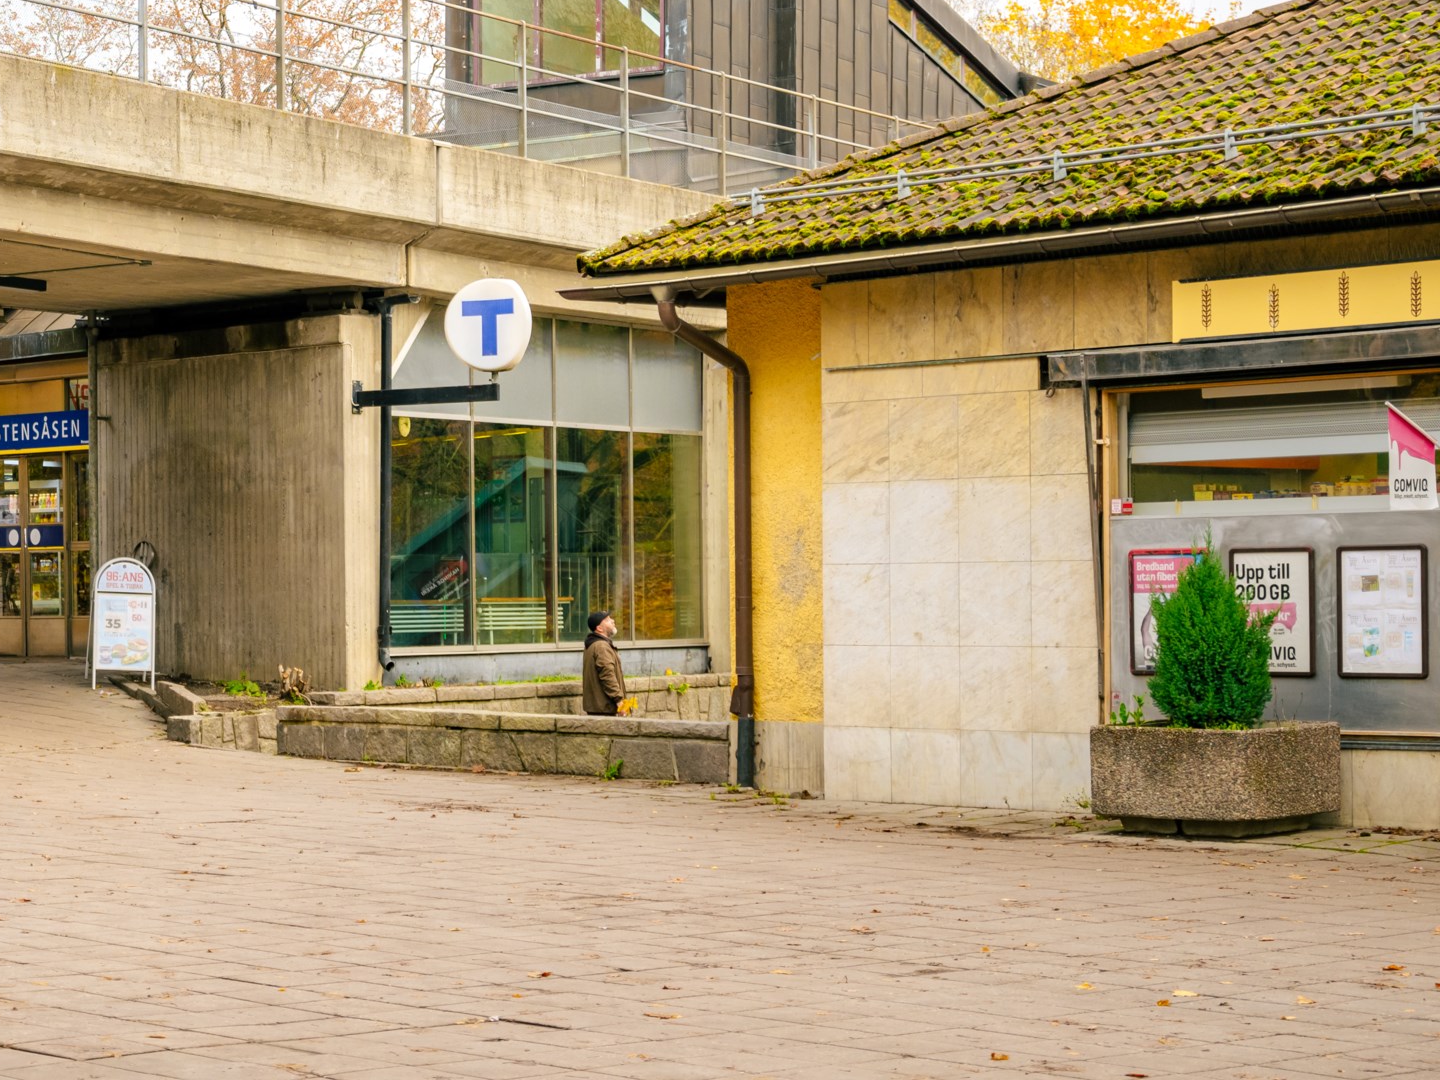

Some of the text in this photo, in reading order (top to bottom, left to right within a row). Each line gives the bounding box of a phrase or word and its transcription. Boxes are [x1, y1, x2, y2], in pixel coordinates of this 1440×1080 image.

[462, 298, 514, 356] T
[1394, 479, 1428, 492] COMVIQ
[1136, 561, 1174, 570] Bredband
[106, 571, 144, 582] 96:ANS
[1136, 573, 1156, 581] utan
[1236, 563, 1289, 583] Upp till
[1236, 584, 1290, 600] 200 GB
[105, 619, 121, 628] 35
[1270, 646, 1296, 660] VIQ
